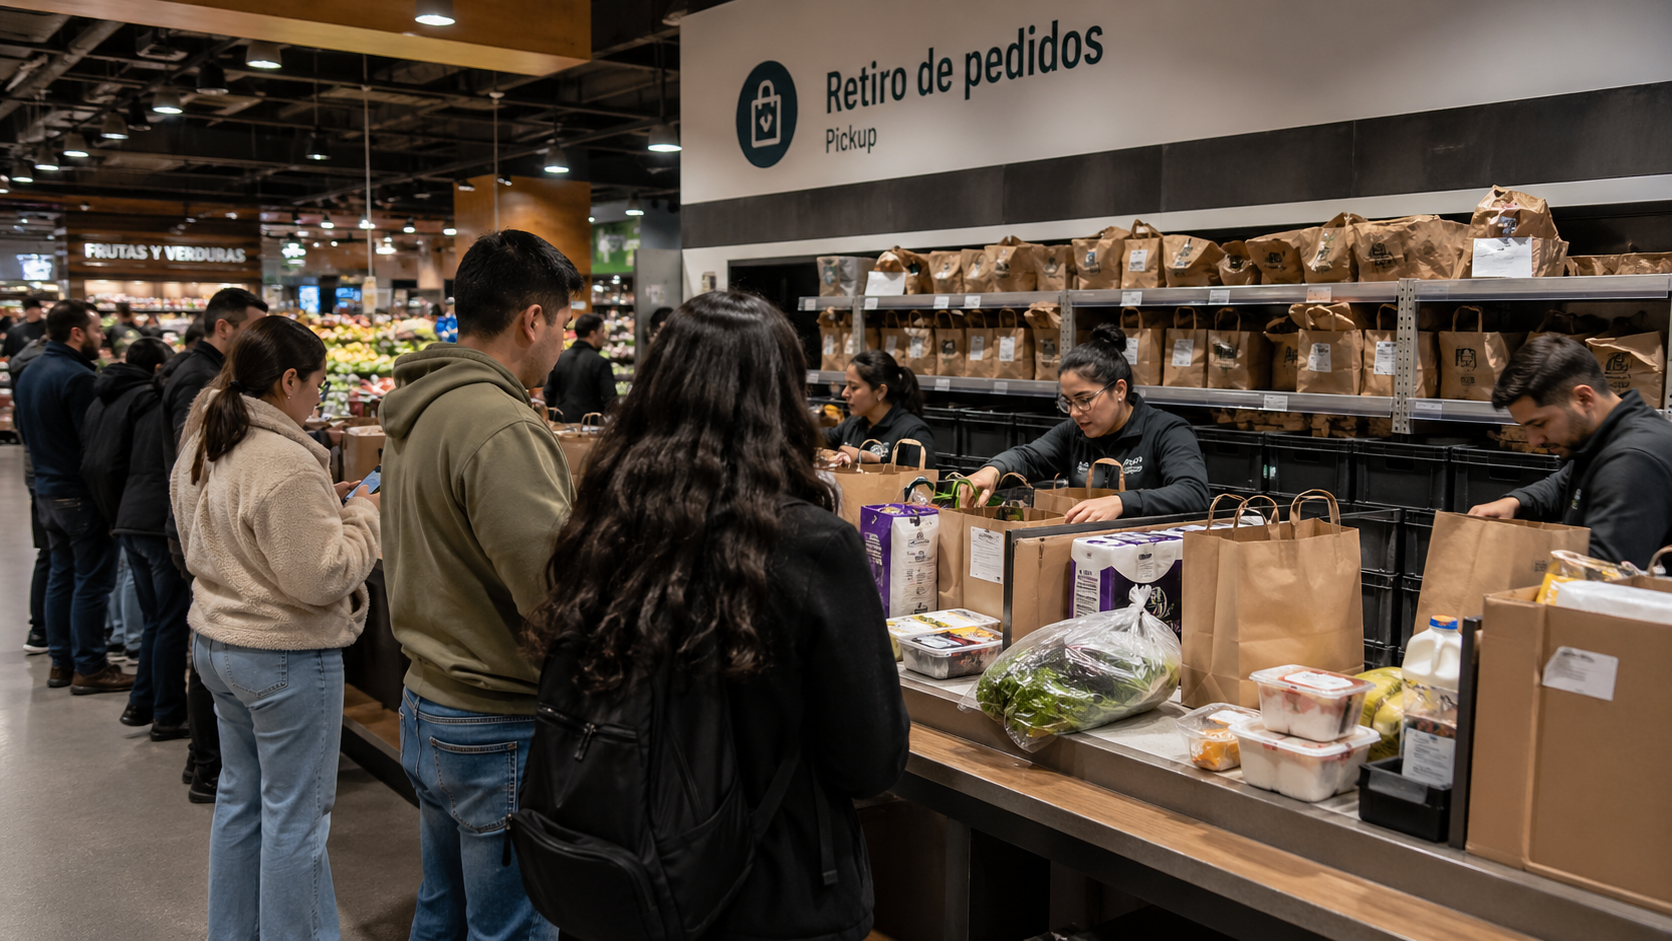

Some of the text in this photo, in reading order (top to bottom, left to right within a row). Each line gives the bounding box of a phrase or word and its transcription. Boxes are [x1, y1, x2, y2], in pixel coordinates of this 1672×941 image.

[827, 19, 1104, 114] Retiro de pedidos
[826, 124, 877, 154] Pickup
[84, 243, 246, 263] FRUTAS Y VERDURAS
